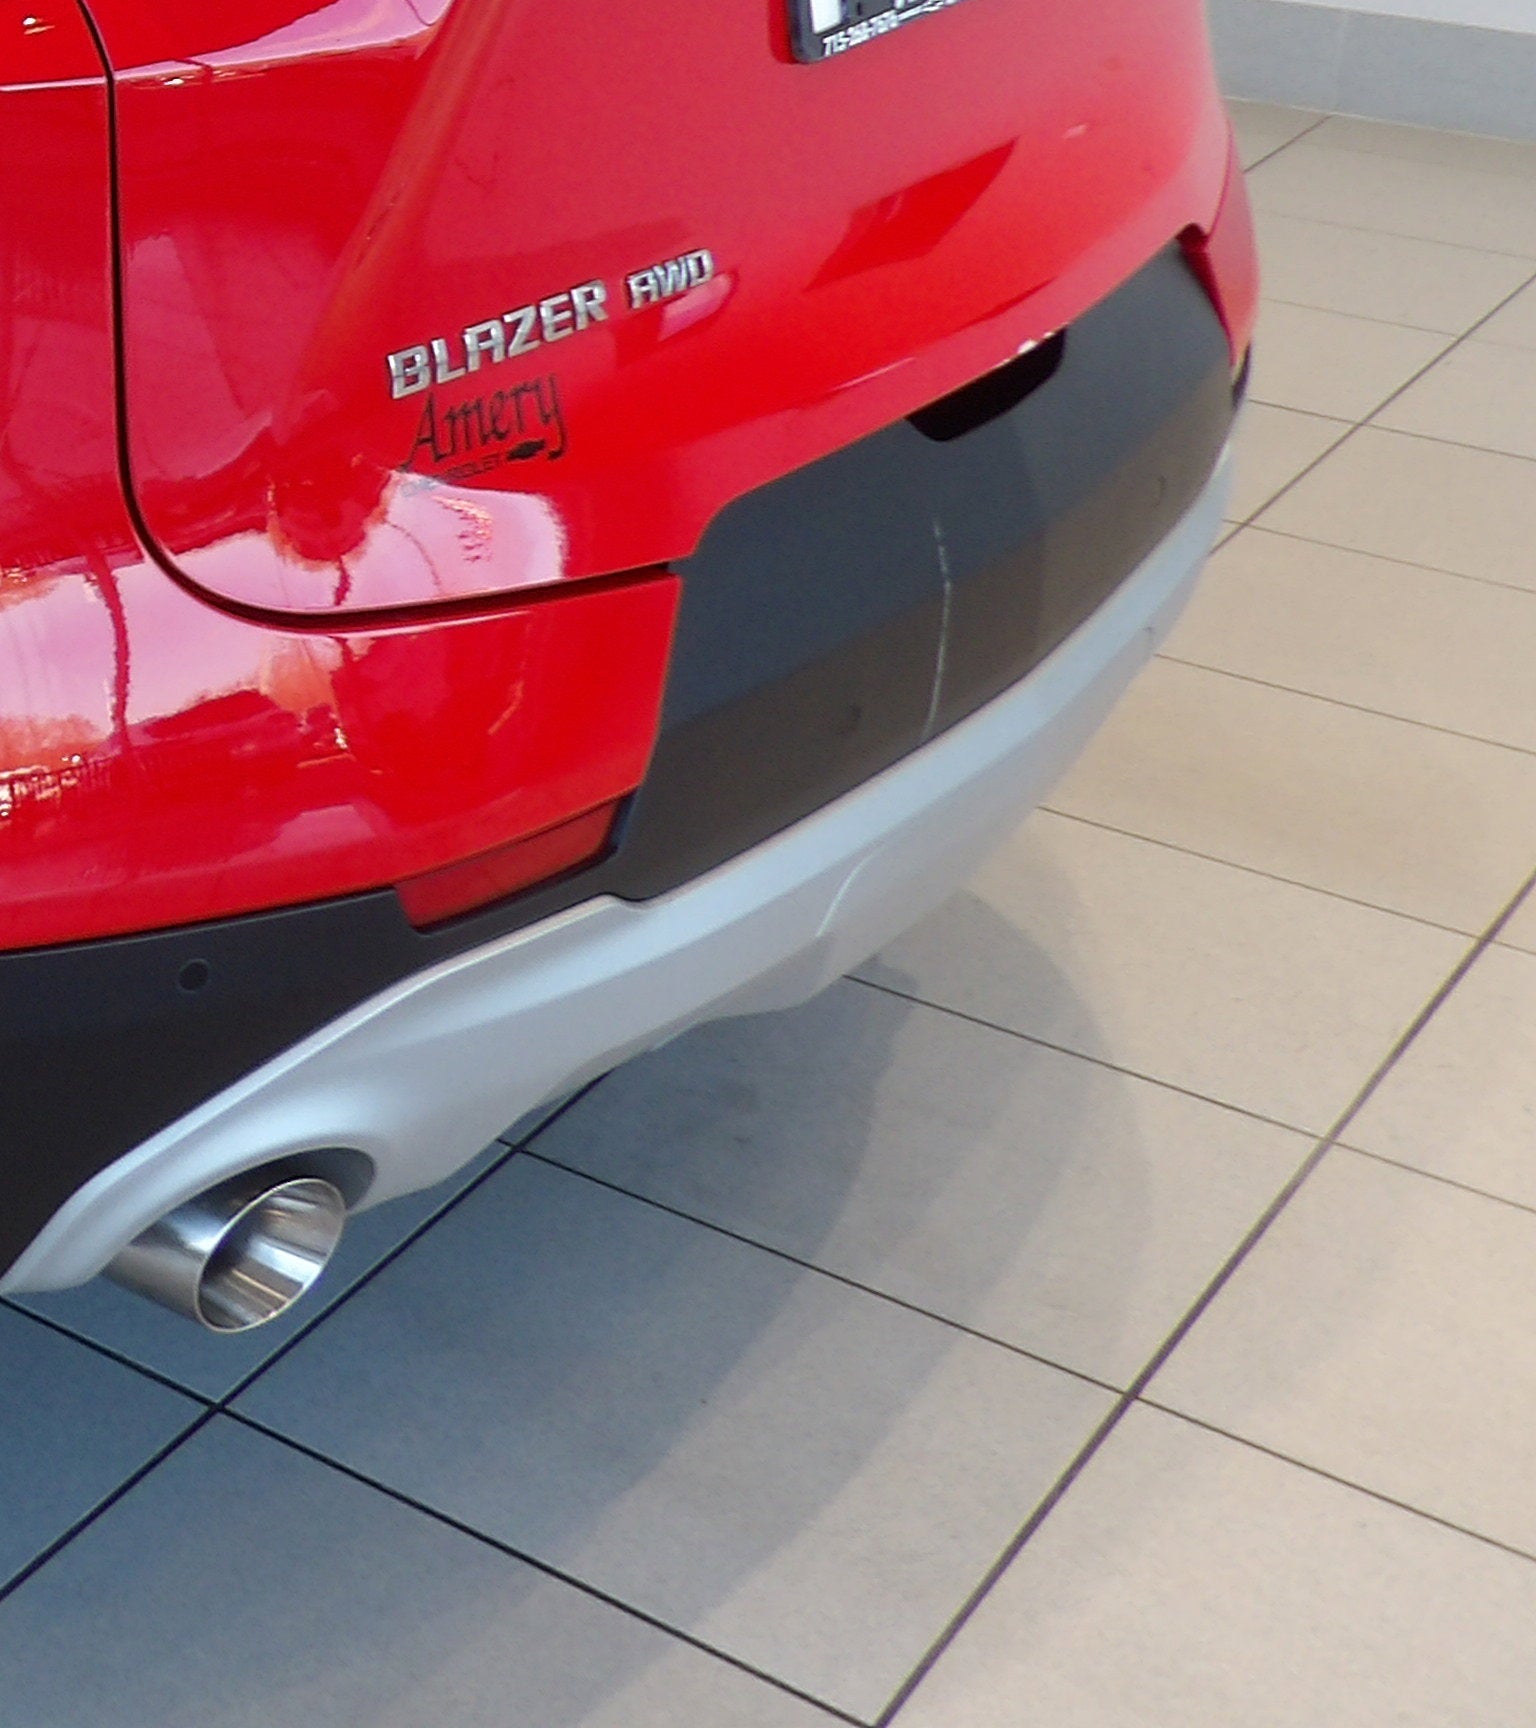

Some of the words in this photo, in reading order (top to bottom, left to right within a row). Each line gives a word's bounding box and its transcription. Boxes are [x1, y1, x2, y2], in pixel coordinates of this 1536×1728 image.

[387, 279, 609, 399] BLAZER
[626, 248, 716, 309] AWD
[399, 373, 568, 472] Amery
